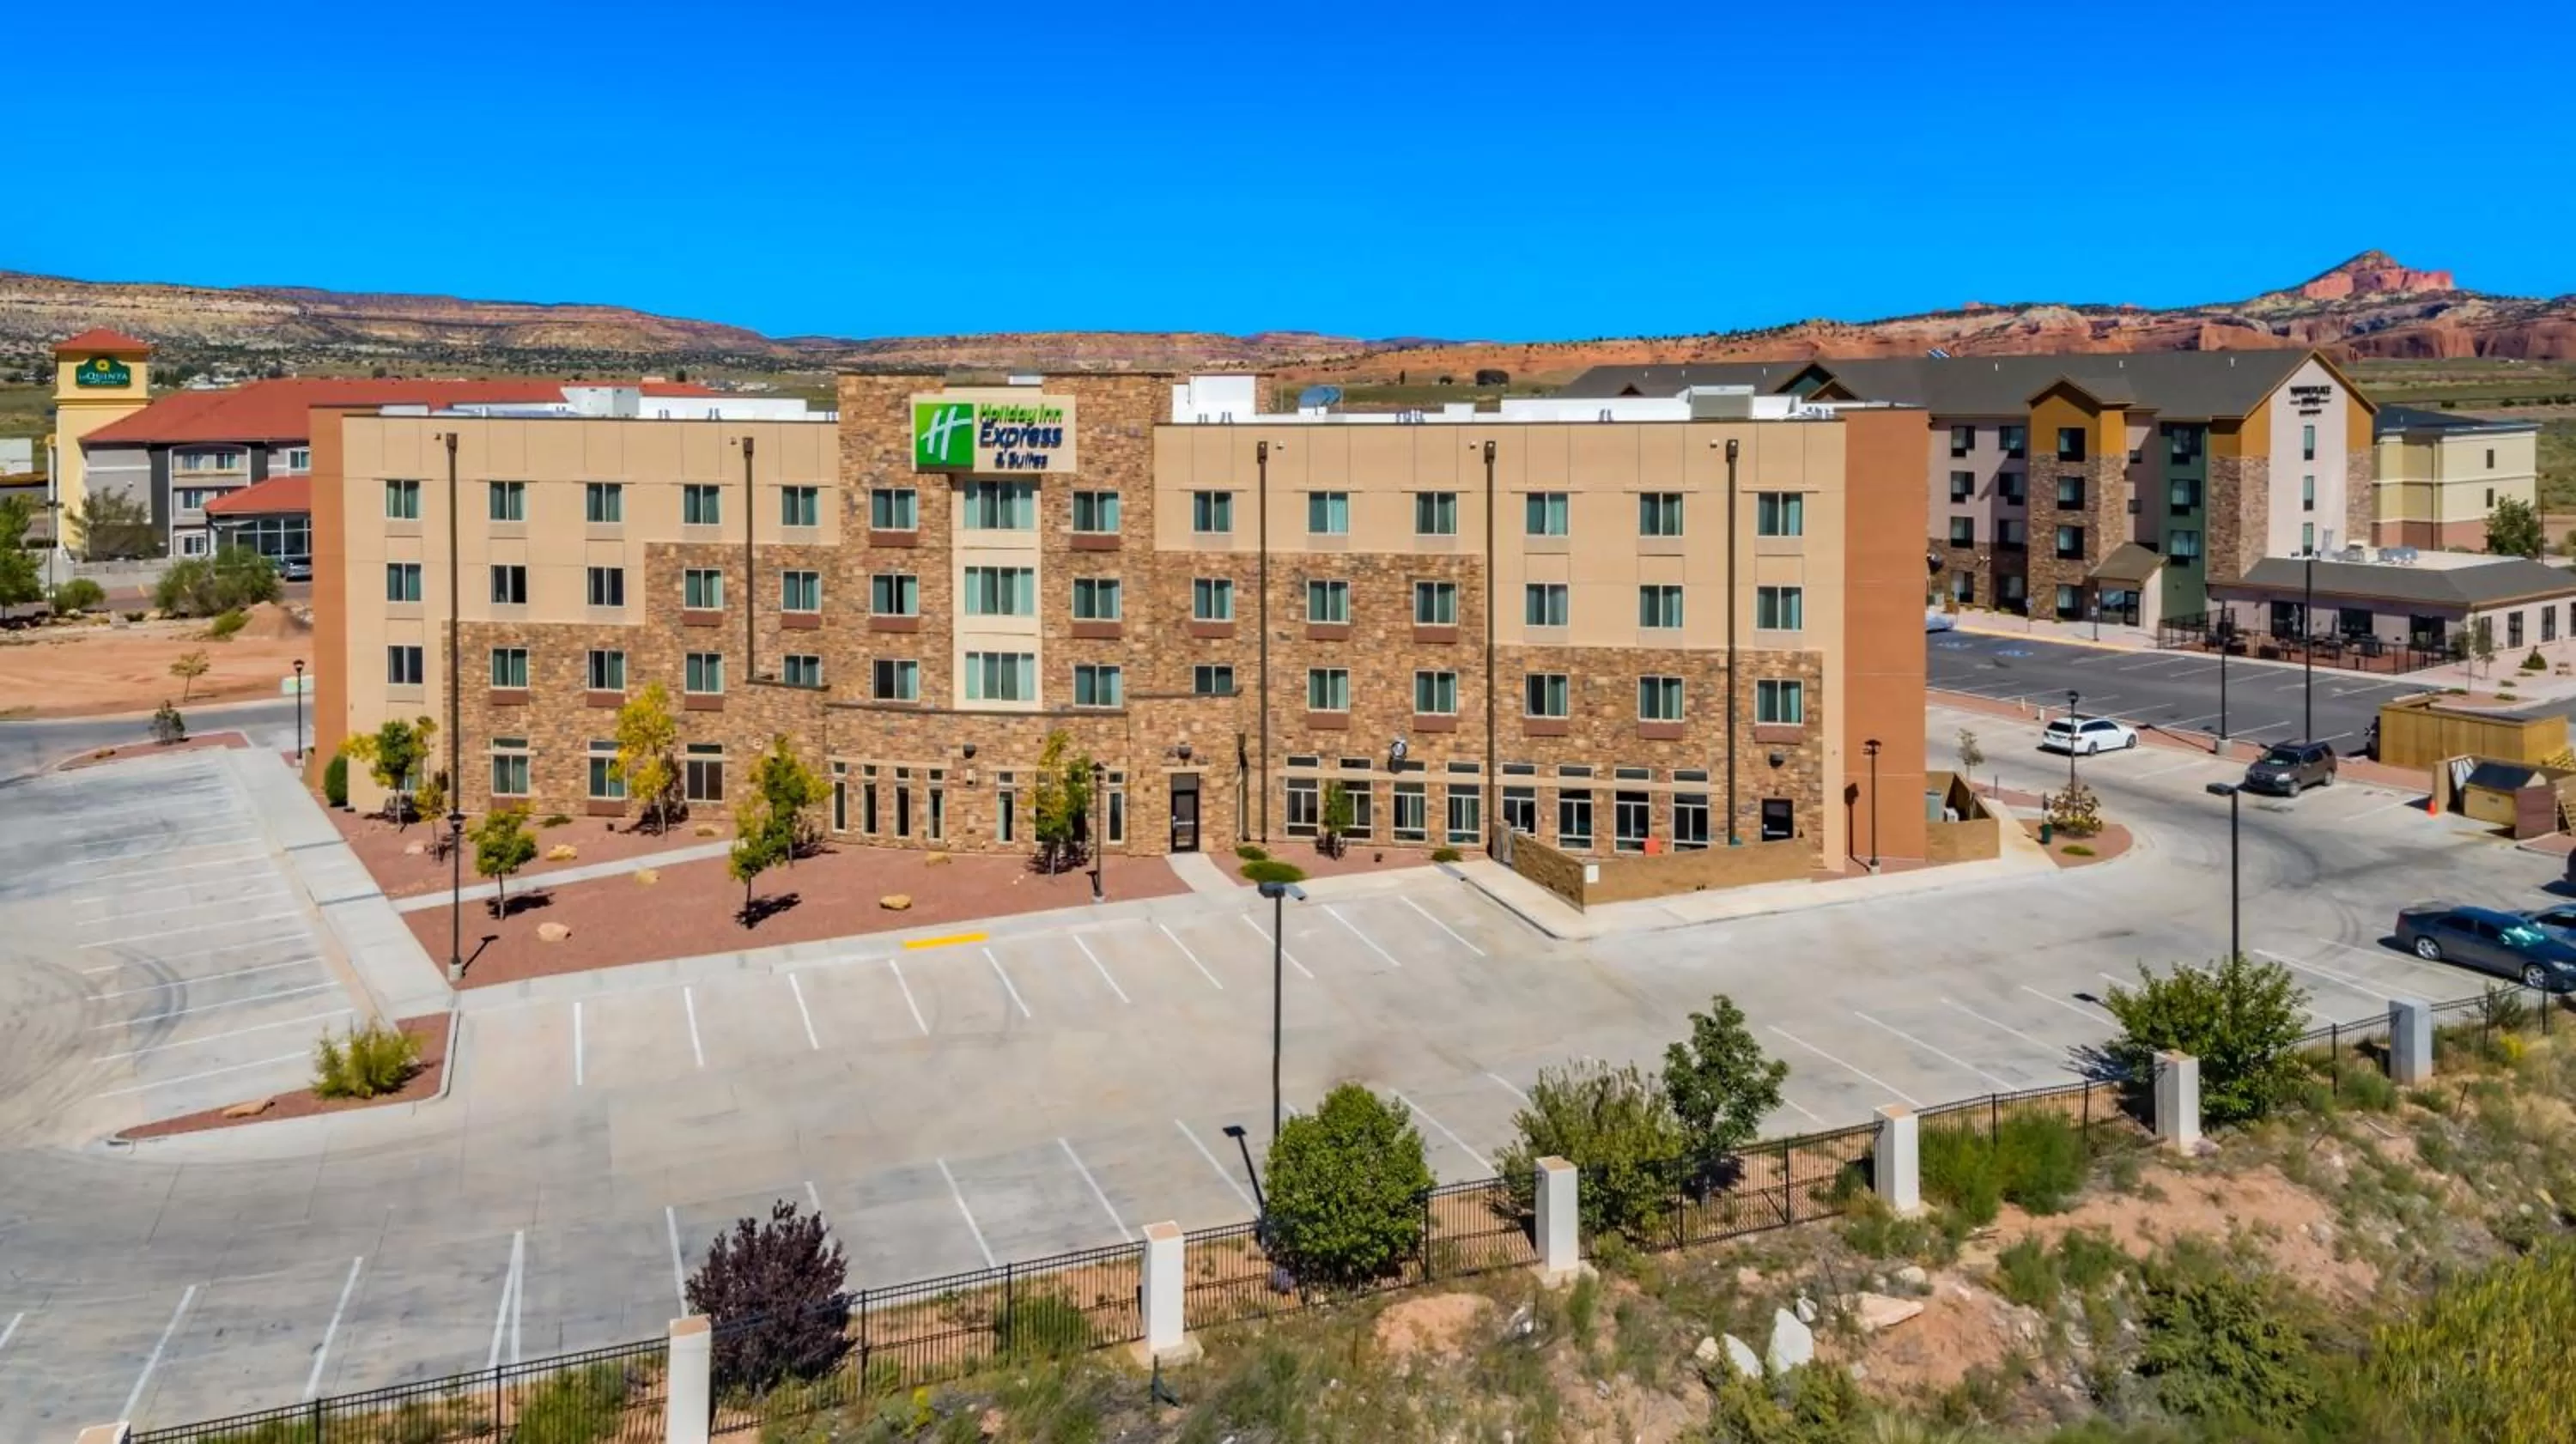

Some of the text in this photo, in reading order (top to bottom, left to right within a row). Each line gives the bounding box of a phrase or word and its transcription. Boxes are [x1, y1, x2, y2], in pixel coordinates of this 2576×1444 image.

[980, 403, 1063, 424] Holiday Inn
[979, 419, 1063, 452] Express
[994, 451, 1048, 470] & Suites
